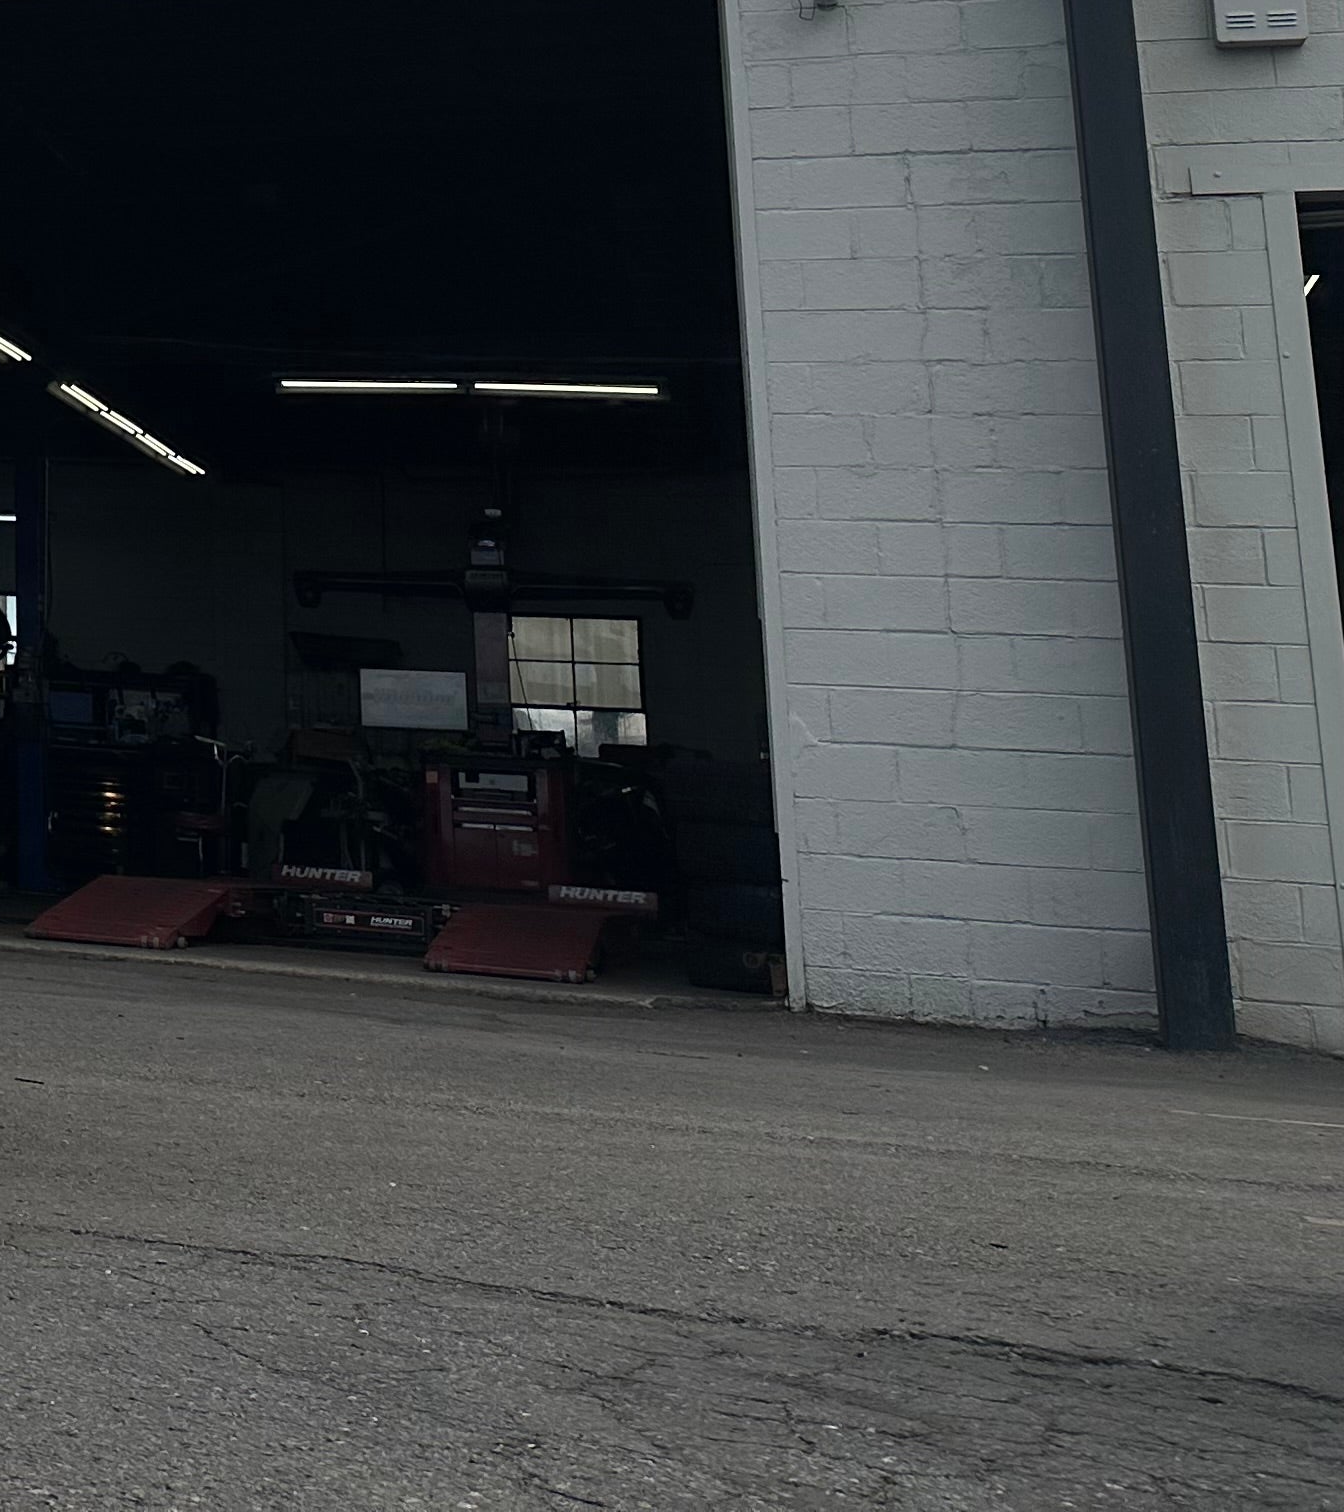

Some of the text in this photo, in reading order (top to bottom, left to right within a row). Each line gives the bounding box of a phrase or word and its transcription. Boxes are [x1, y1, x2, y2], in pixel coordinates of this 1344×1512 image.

[280, 864, 362, 883] HUNTER
[559, 885, 647, 905] HUNTER
[370, 916, 413, 927] HUNTER
